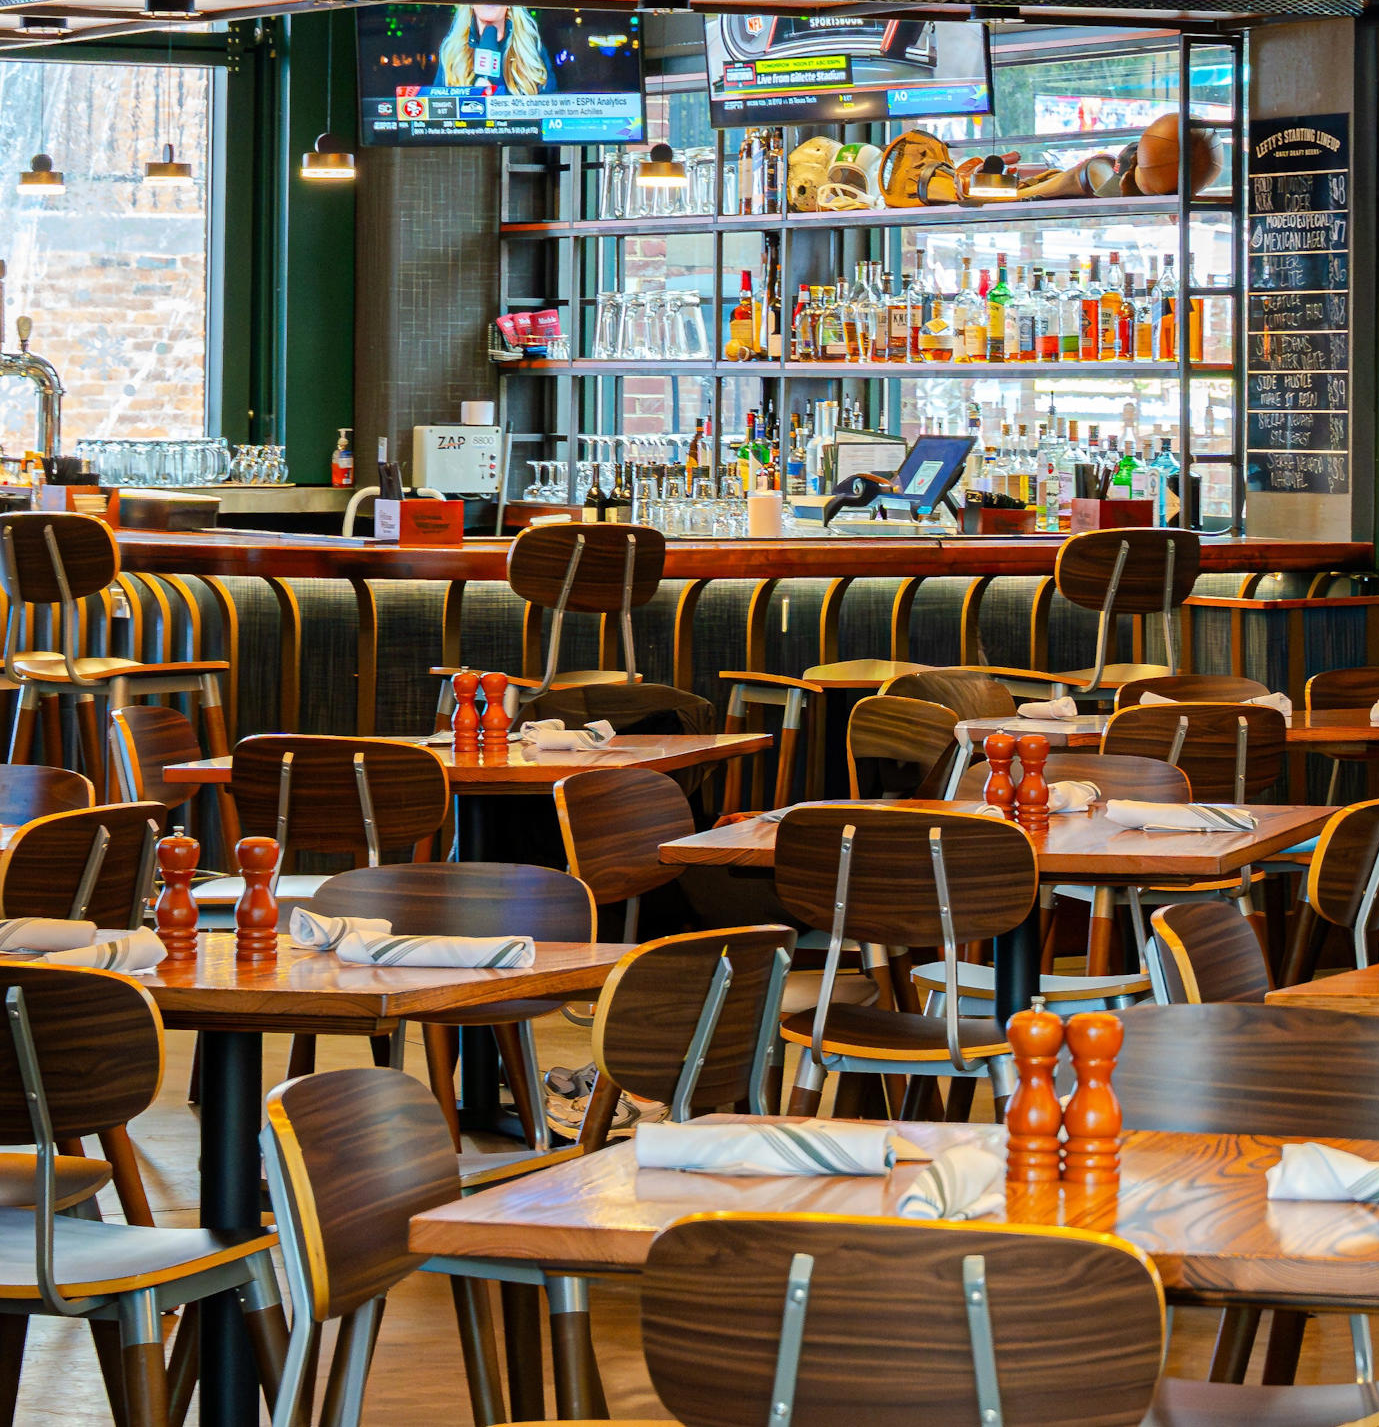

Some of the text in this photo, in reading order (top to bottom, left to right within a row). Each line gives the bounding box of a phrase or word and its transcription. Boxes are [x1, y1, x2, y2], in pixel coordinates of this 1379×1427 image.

[1256, 128, 1341, 158] LEFTY'S STARTING LINEUP
[437, 436, 466, 449] ZAP
